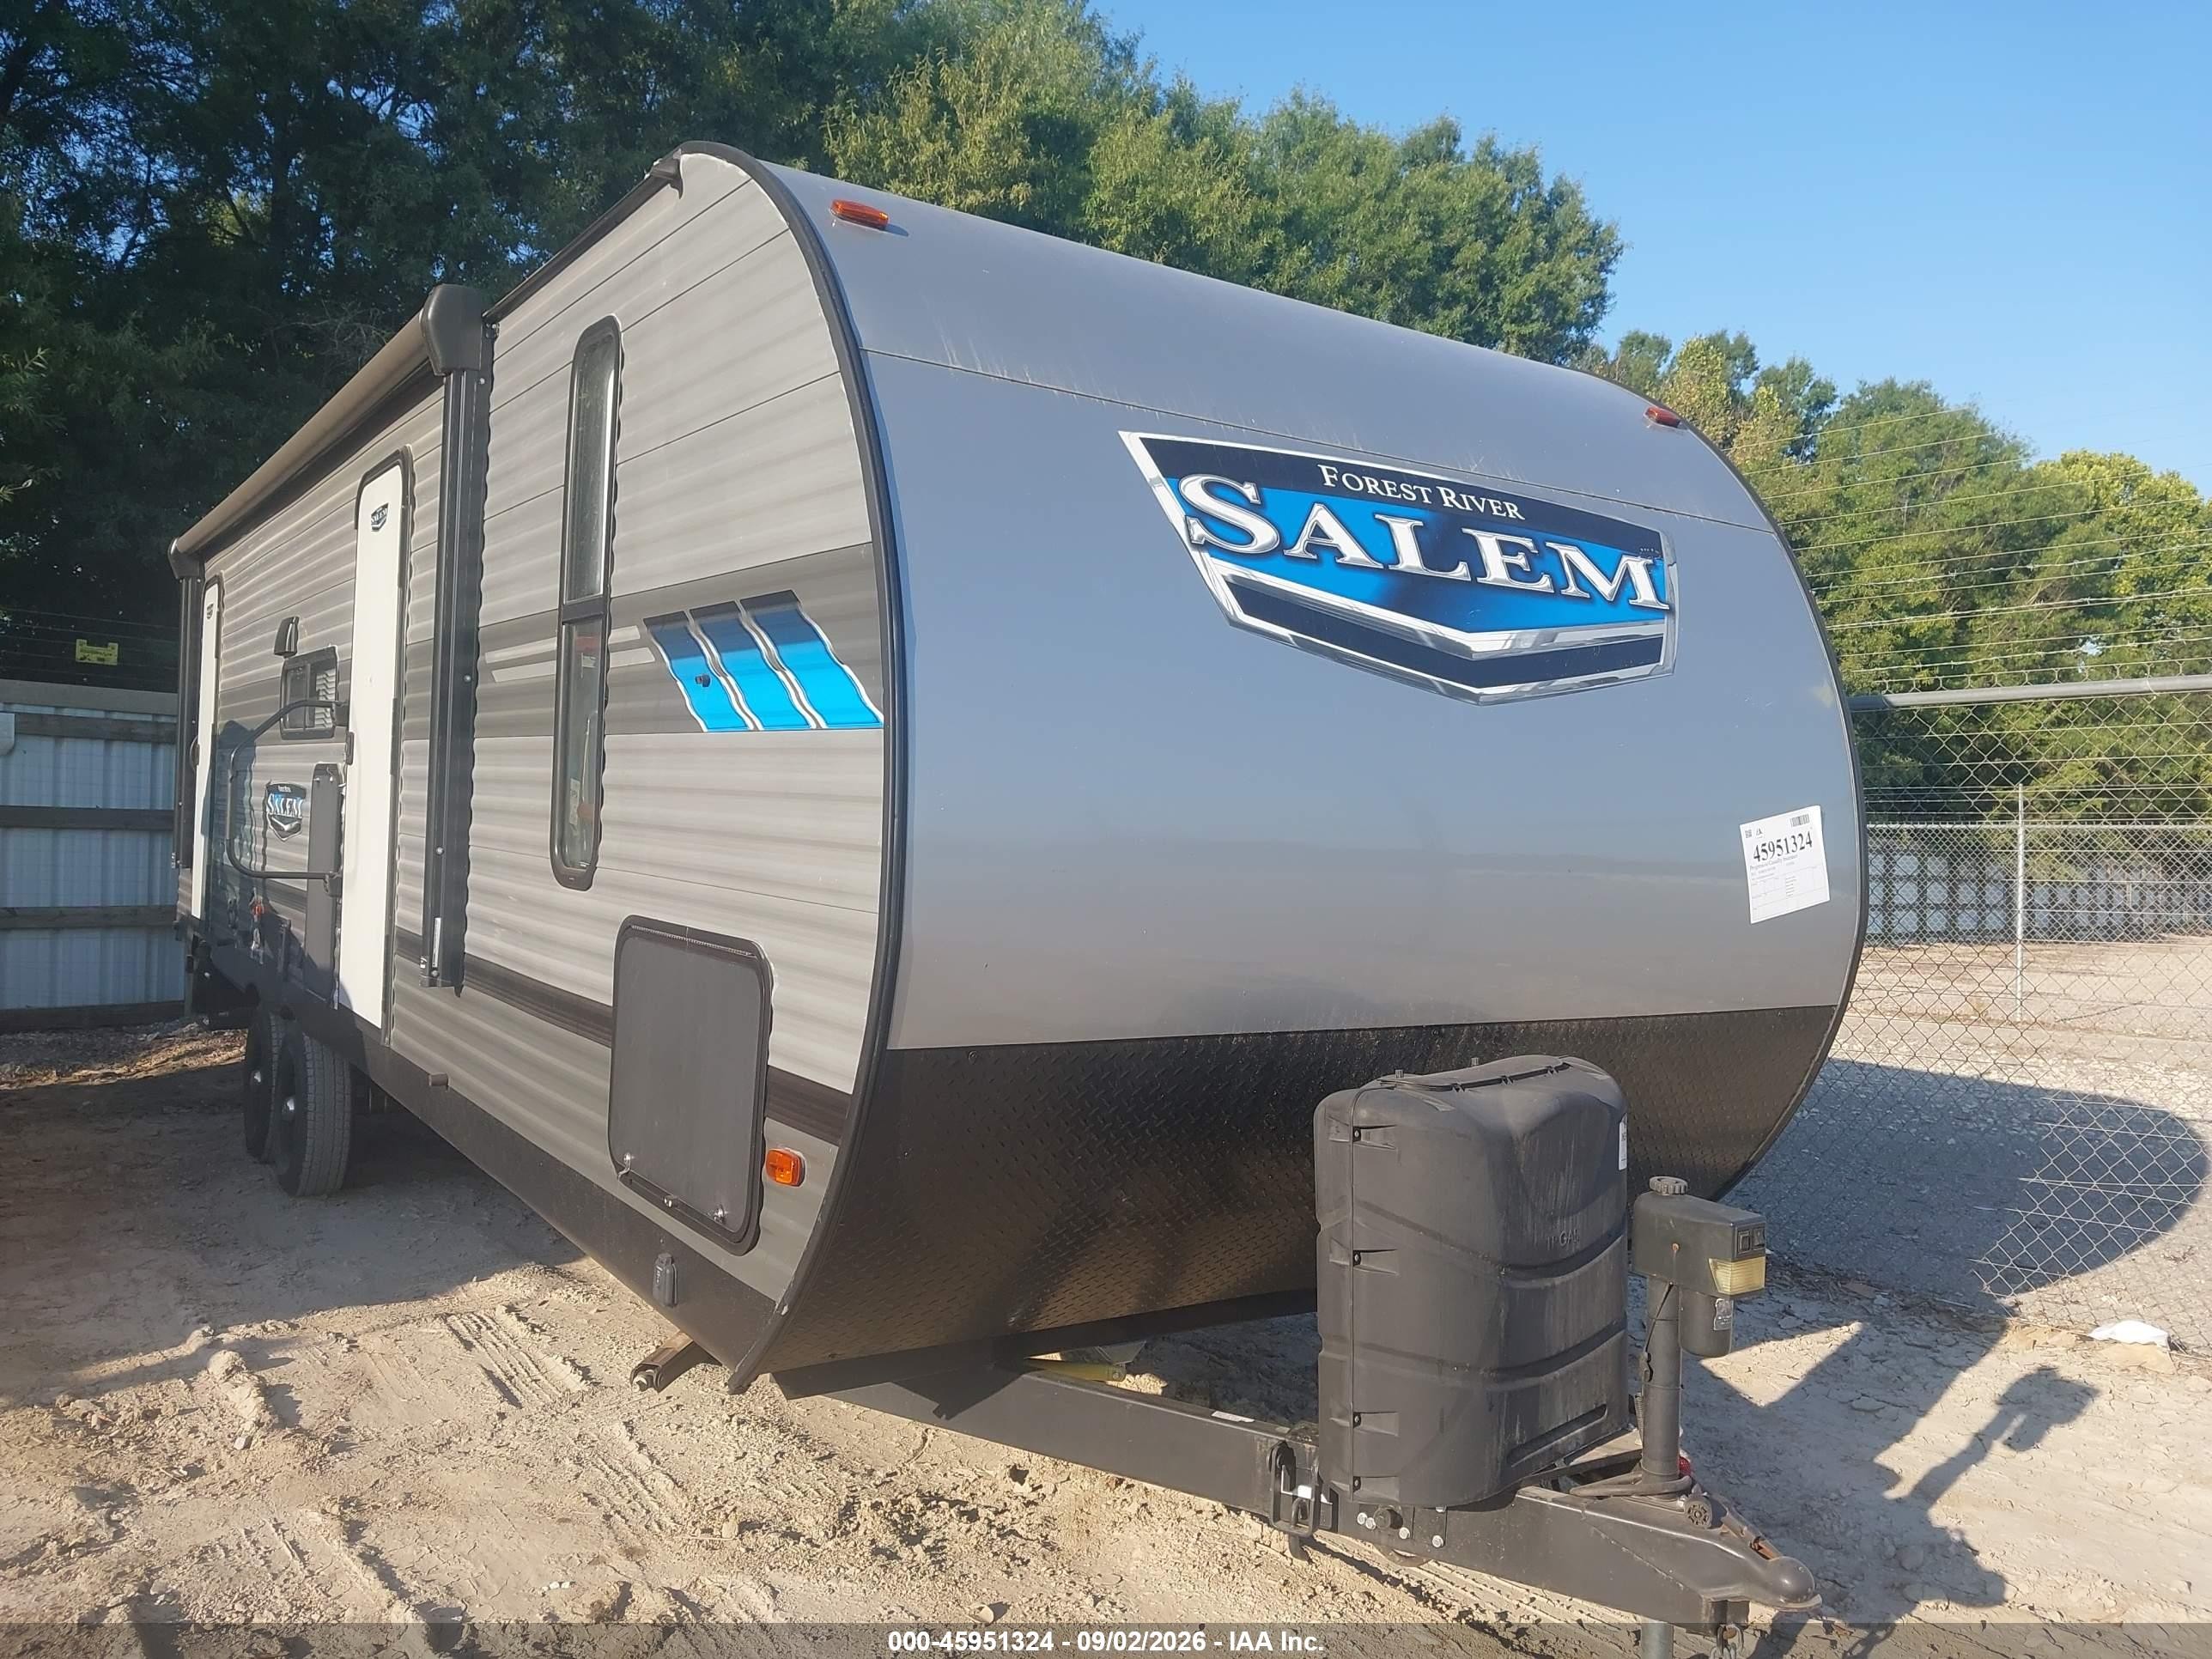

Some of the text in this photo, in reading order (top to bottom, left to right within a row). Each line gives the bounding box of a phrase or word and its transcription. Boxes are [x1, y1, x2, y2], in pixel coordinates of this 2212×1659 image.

[1317, 464, 1526, 520] FOREST RIVER
[1177, 472, 1670, 611] SALEM
[1753, 830, 1813, 862] 45951324
